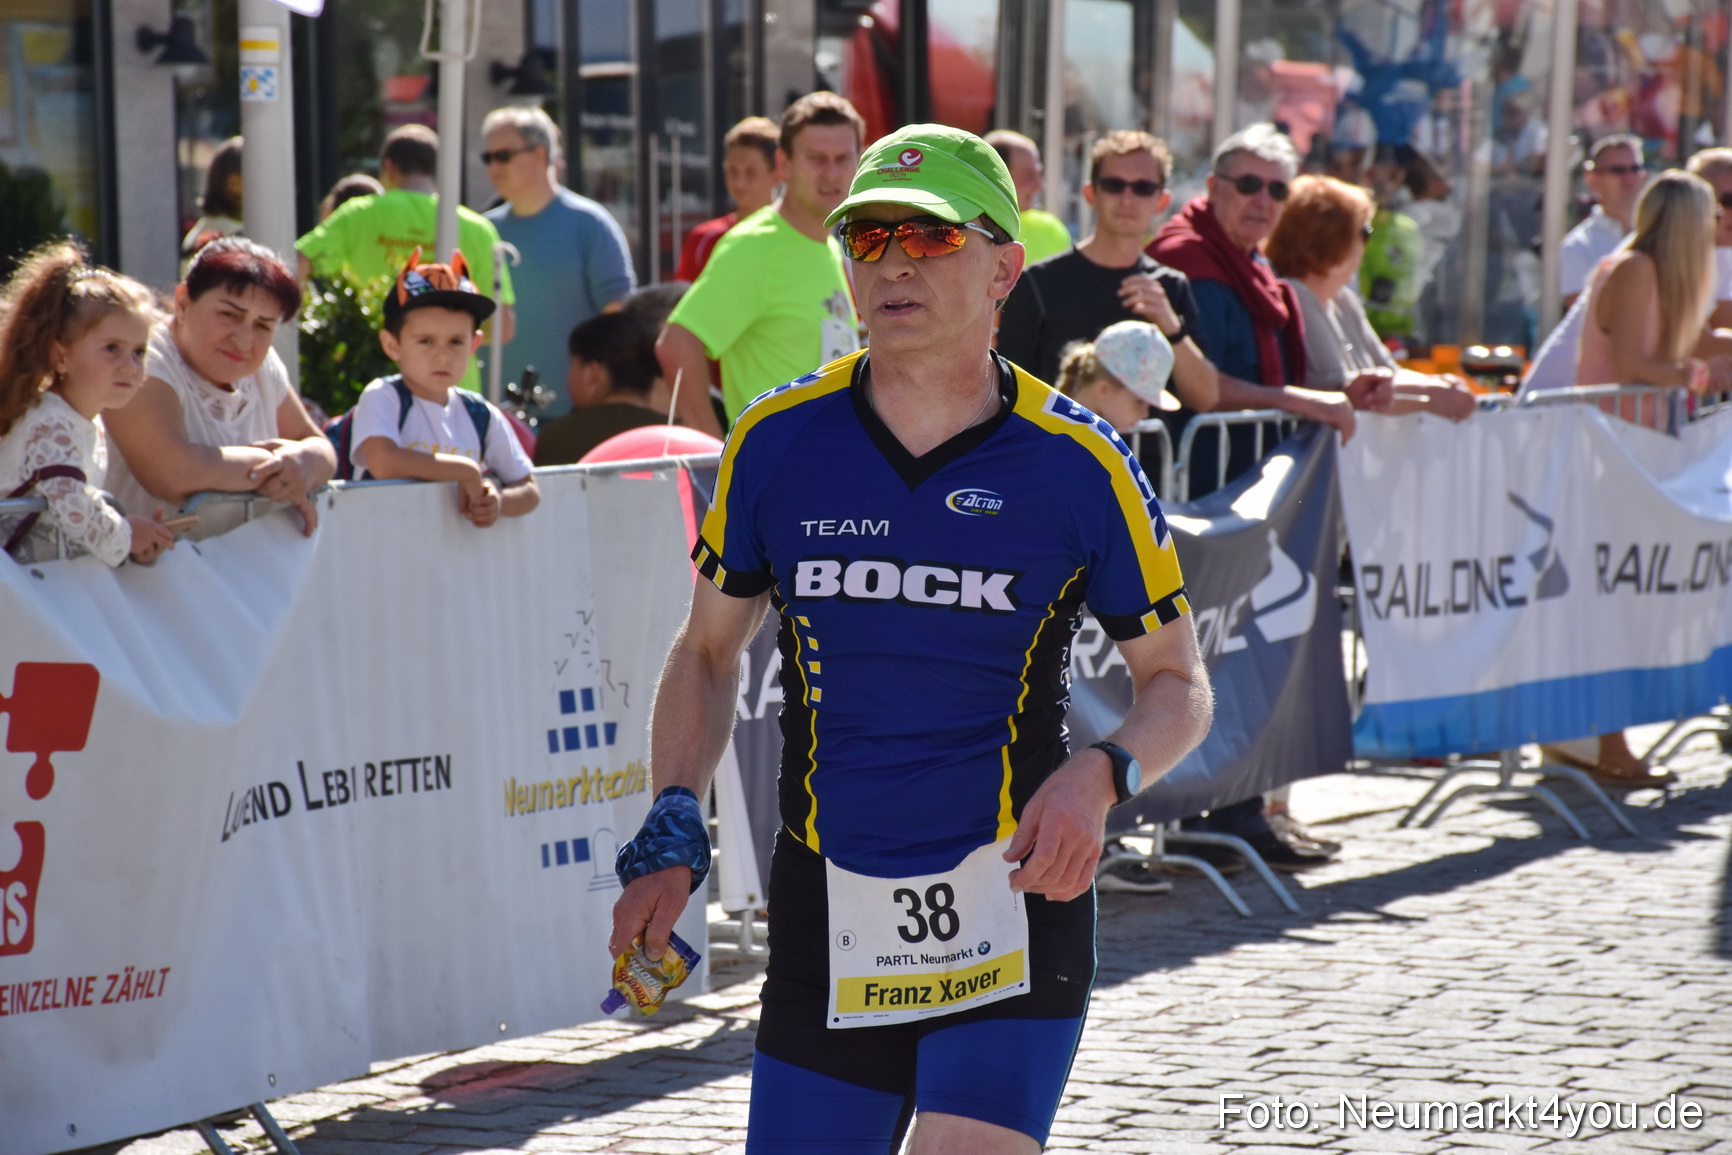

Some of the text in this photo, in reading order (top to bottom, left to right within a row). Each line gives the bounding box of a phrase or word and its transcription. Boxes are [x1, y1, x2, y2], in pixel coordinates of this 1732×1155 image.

[800, 519, 890, 537] TEAM
[794, 558, 1018, 612] BOCK
[364, 753, 452, 799] RETTEN
[893, 882, 960, 944] 38
[876, 948, 974, 967] PARTL Neumarkt
[101, 966, 171, 1005] ZÄHLT
[864, 982, 932, 1007] Franz
[939, 967, 1001, 1003] Xaver
